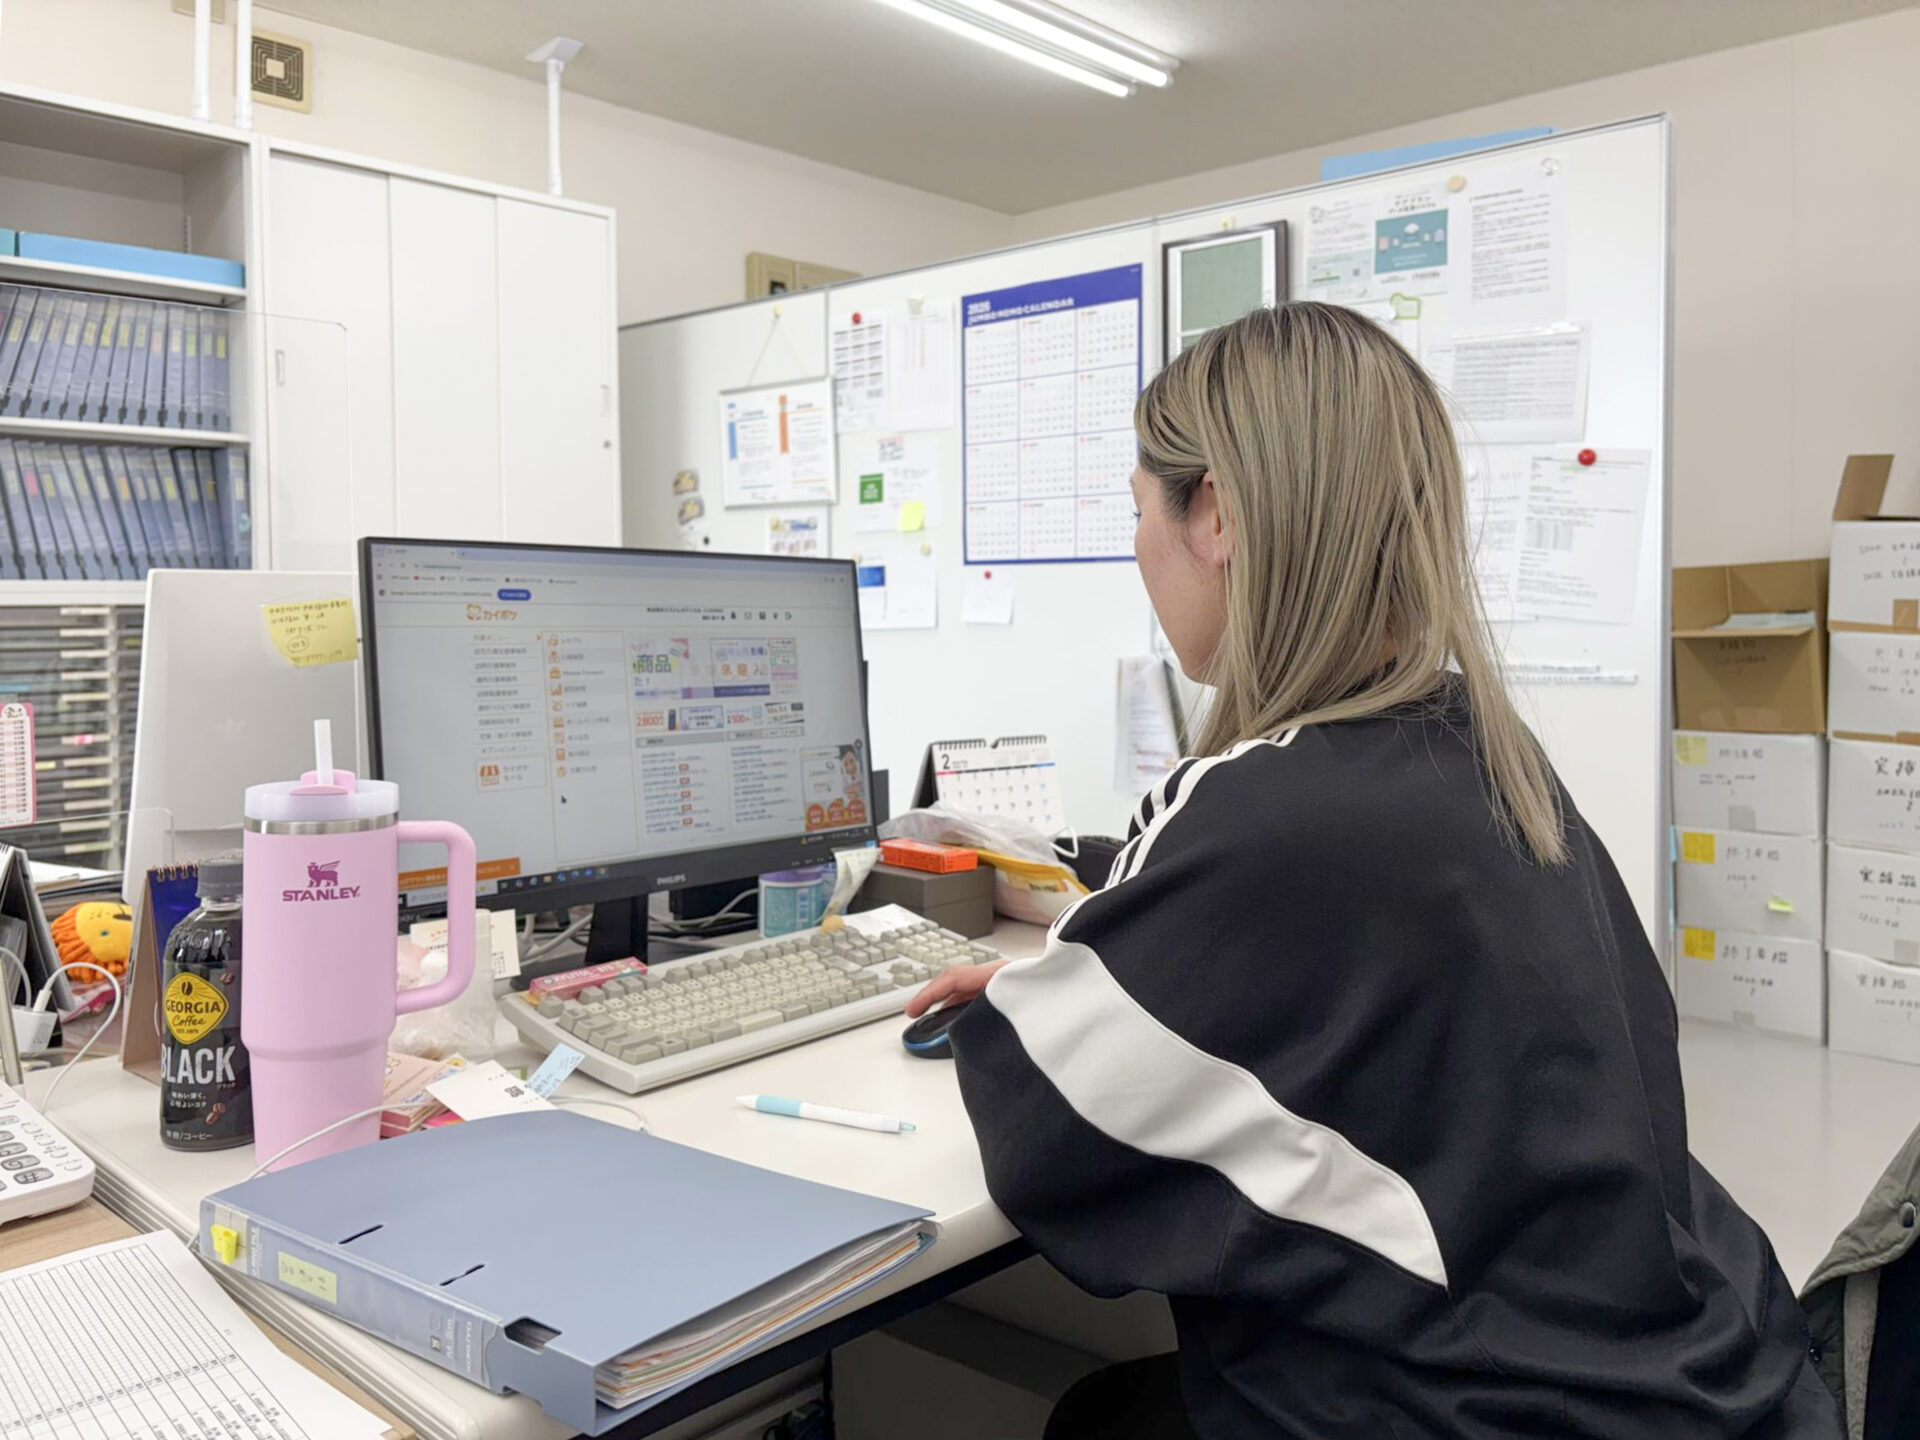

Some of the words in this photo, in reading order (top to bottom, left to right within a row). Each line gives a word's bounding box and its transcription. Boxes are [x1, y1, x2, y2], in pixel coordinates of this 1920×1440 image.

[1024, 297, 1074, 312] CALENDAR
[942, 754, 951, 770] 2
[282, 886, 359, 902] STANLEY
[165, 1000, 221, 1014] GEORGIA
[172, 1014, 206, 1028] Coffee
[161, 1043, 236, 1084] BLACK
